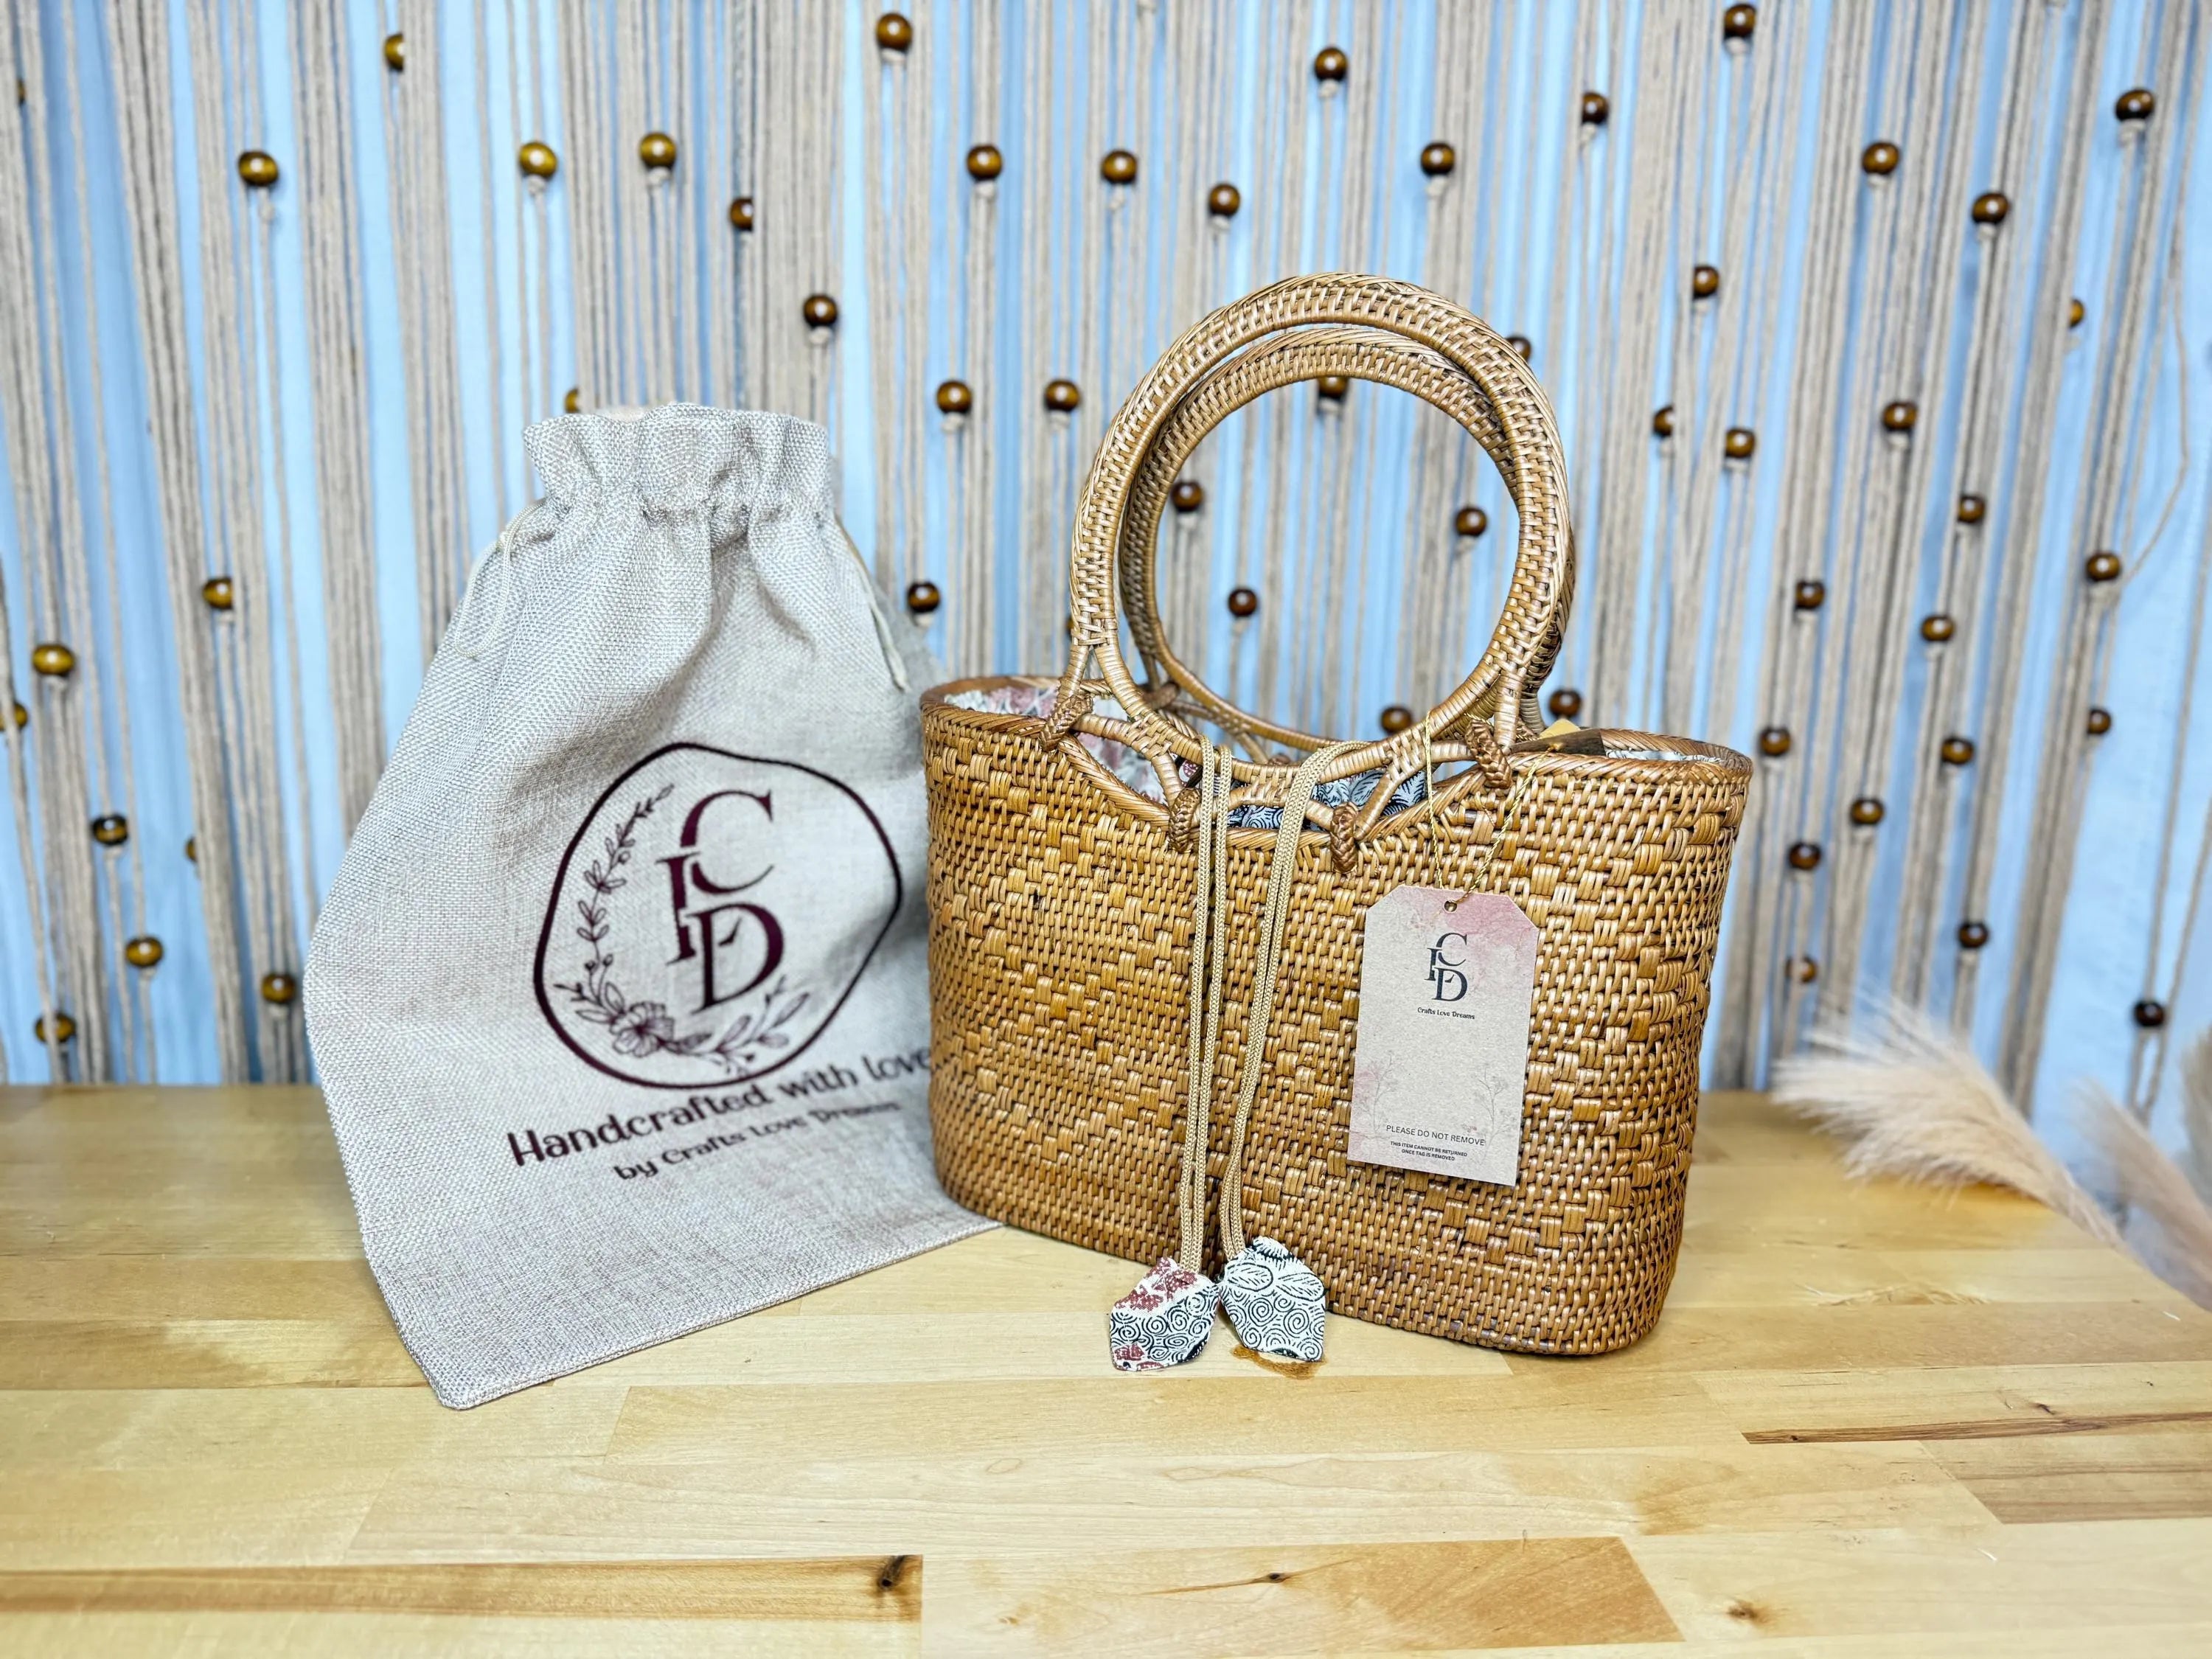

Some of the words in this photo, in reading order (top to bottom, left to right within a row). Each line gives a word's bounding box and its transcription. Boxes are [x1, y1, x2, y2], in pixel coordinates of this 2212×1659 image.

[1452, 1011, 1475, 1019] Dreams
[507, 1084, 772, 1166] Handcrafted
[778, 1065, 858, 1097] with
[861, 1048, 931, 1081] love
[1386, 1124, 1416, 1135] PLEASE
[1417, 1129, 1430, 1138] DO
[1431, 1131, 1449, 1140] NOT
[1450, 1135, 1485, 1146] REMOVE
[613, 1161, 658, 1180] by
[661, 1133, 745, 1164] Crafts
[1431, 1153, 1455, 1161] REMOVED
[1442, 1149, 1467, 1157] RETURNED
